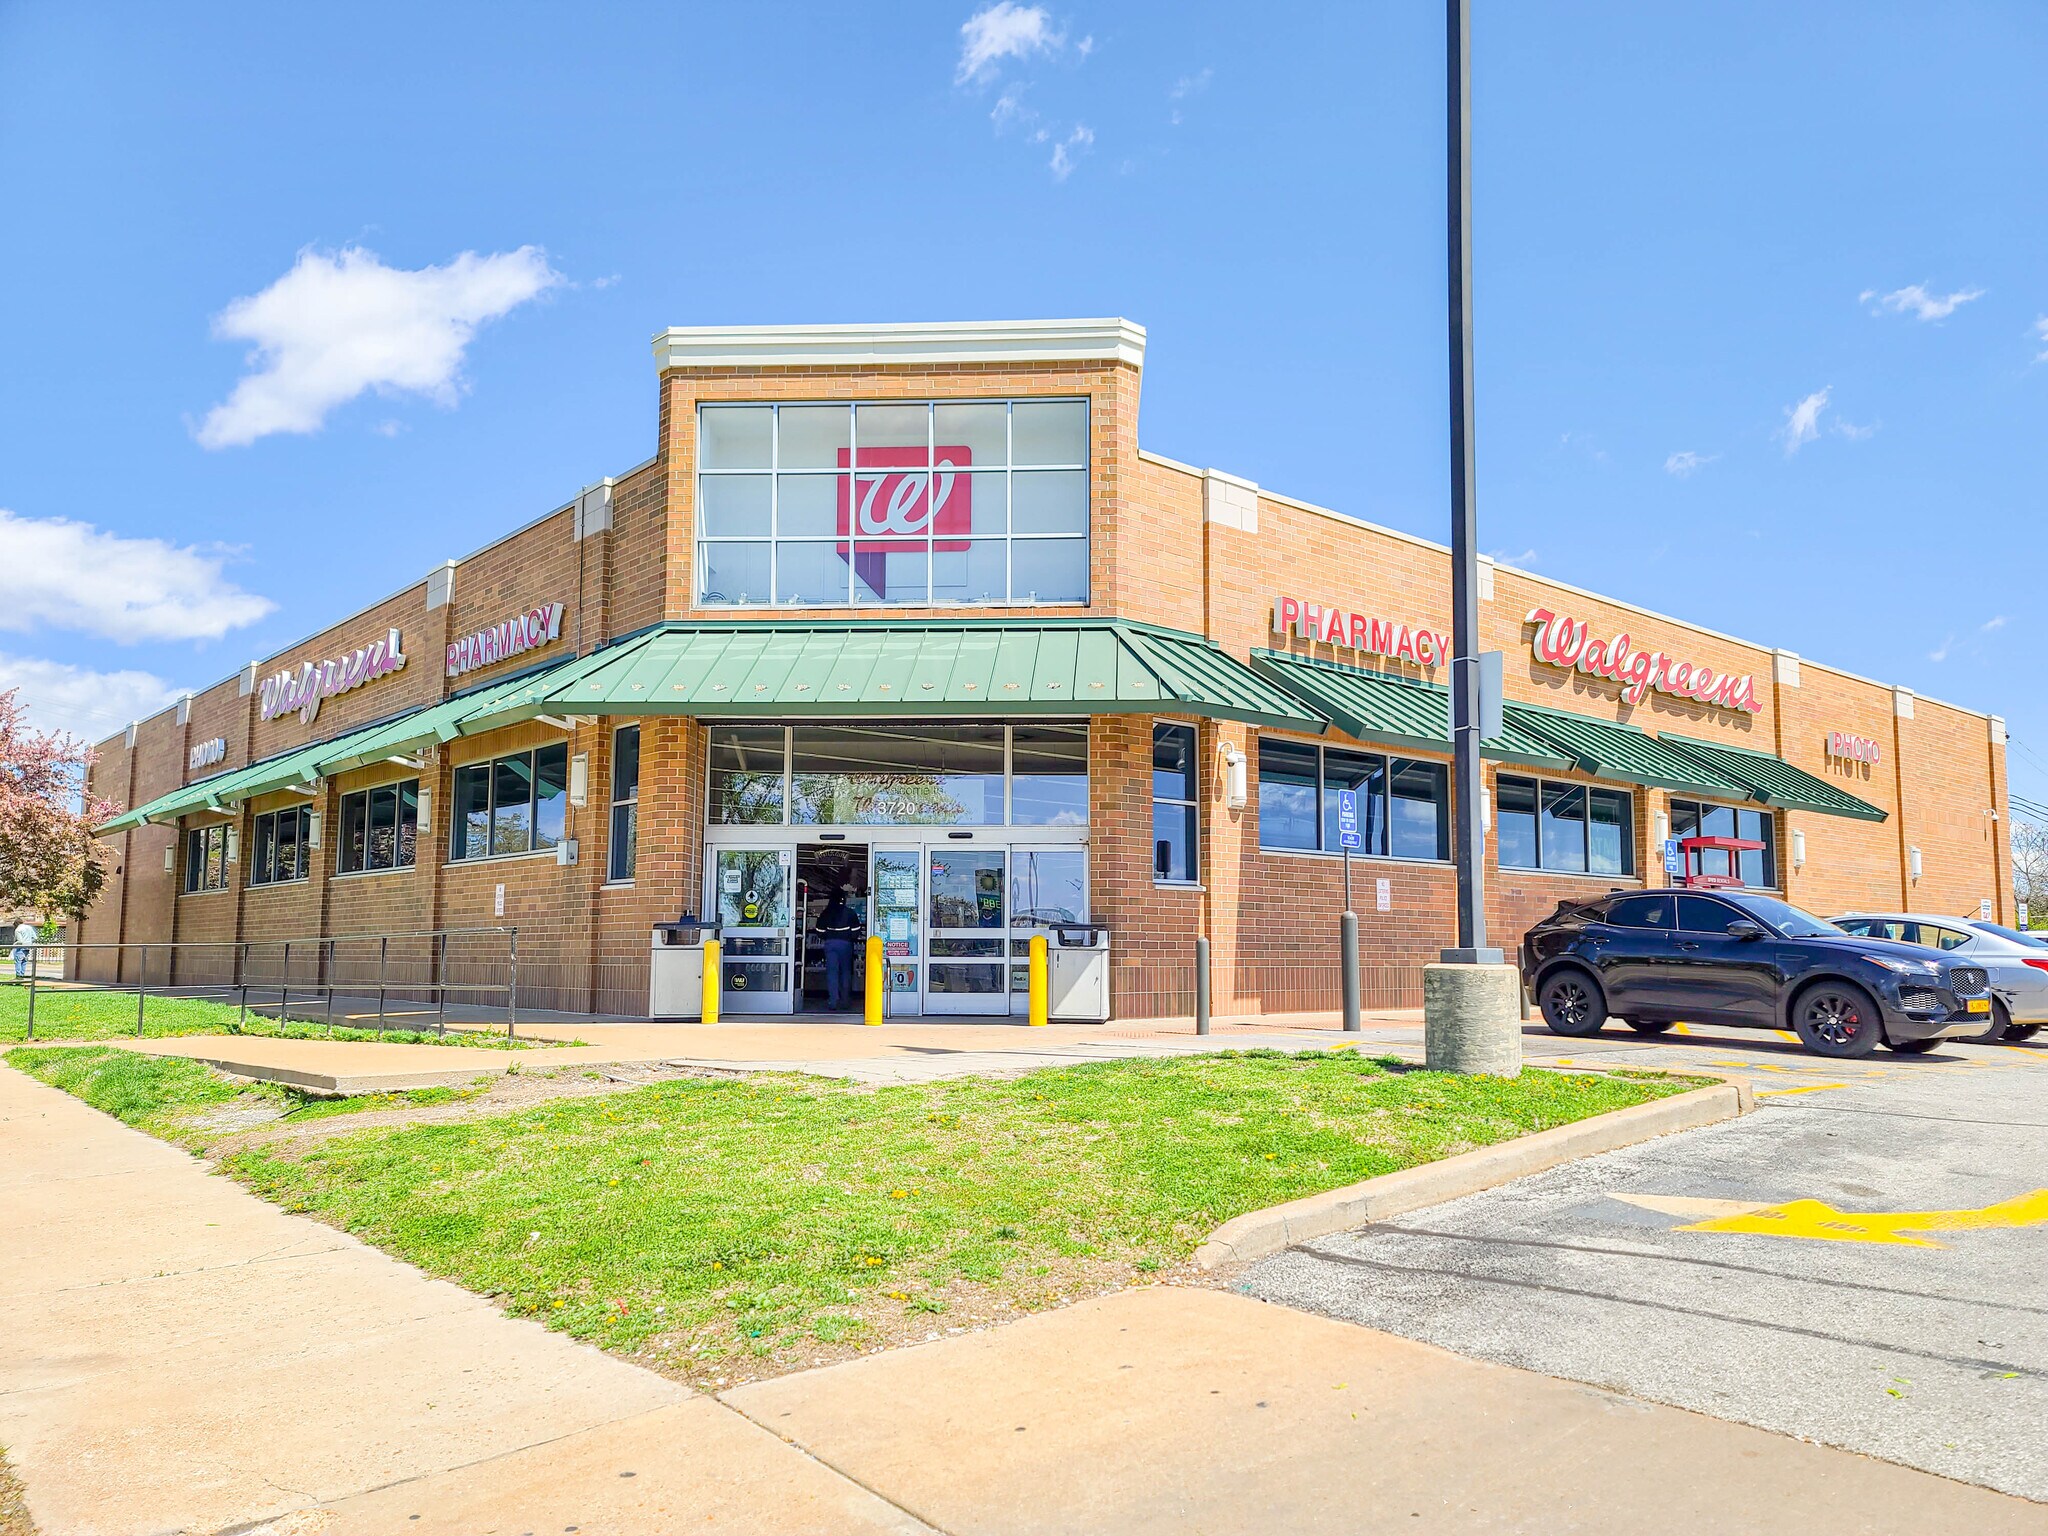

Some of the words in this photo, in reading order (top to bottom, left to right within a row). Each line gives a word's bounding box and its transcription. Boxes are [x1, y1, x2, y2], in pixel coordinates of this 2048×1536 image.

[446, 603, 562, 677] PHARMACY
[1275, 597, 1450, 667] PHARMACY
[1525, 608, 1763, 713] Walgreens
[258, 628, 406, 725] Walgreens
[1829, 732, 1880, 764] PHOTO
[877, 801, 915, 815] 3720
